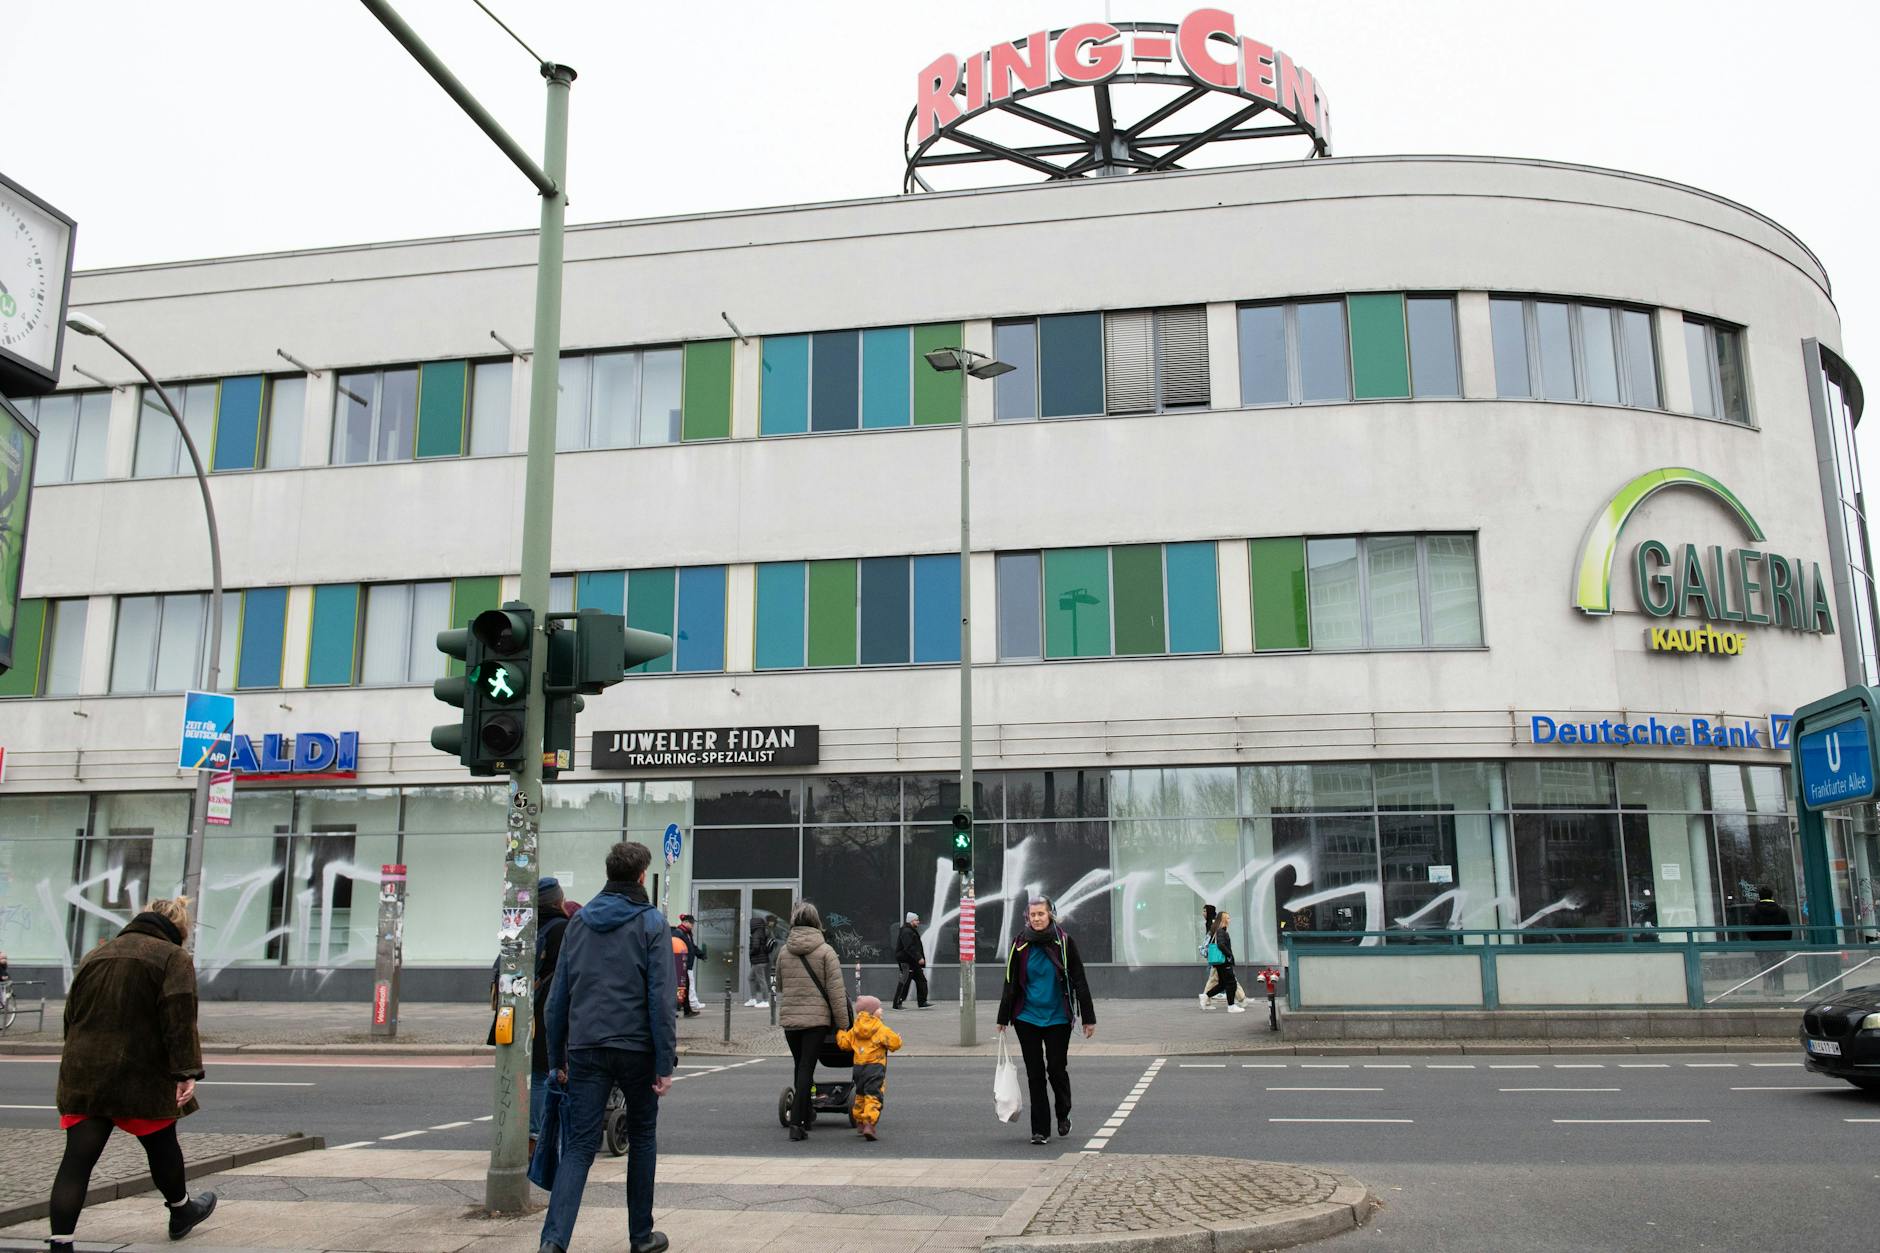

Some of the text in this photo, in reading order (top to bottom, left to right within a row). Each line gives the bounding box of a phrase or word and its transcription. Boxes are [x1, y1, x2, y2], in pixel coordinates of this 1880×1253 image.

[1634, 539, 1836, 636] GALERIA
[185, 720, 217, 732] ZEIT FÜR
[609, 728, 796, 753] JUWELIER FIDAN
[1531, 714, 1761, 749] Deutsche Bank
[209, 751, 226, 763] AfD
[229, 731, 359, 772] ALDI
[628, 750, 776, 766] TRAURING-SPEZIALIST
[1825, 731, 1841, 774] U
[1811, 772, 1867, 801] Frankfurter Allee
